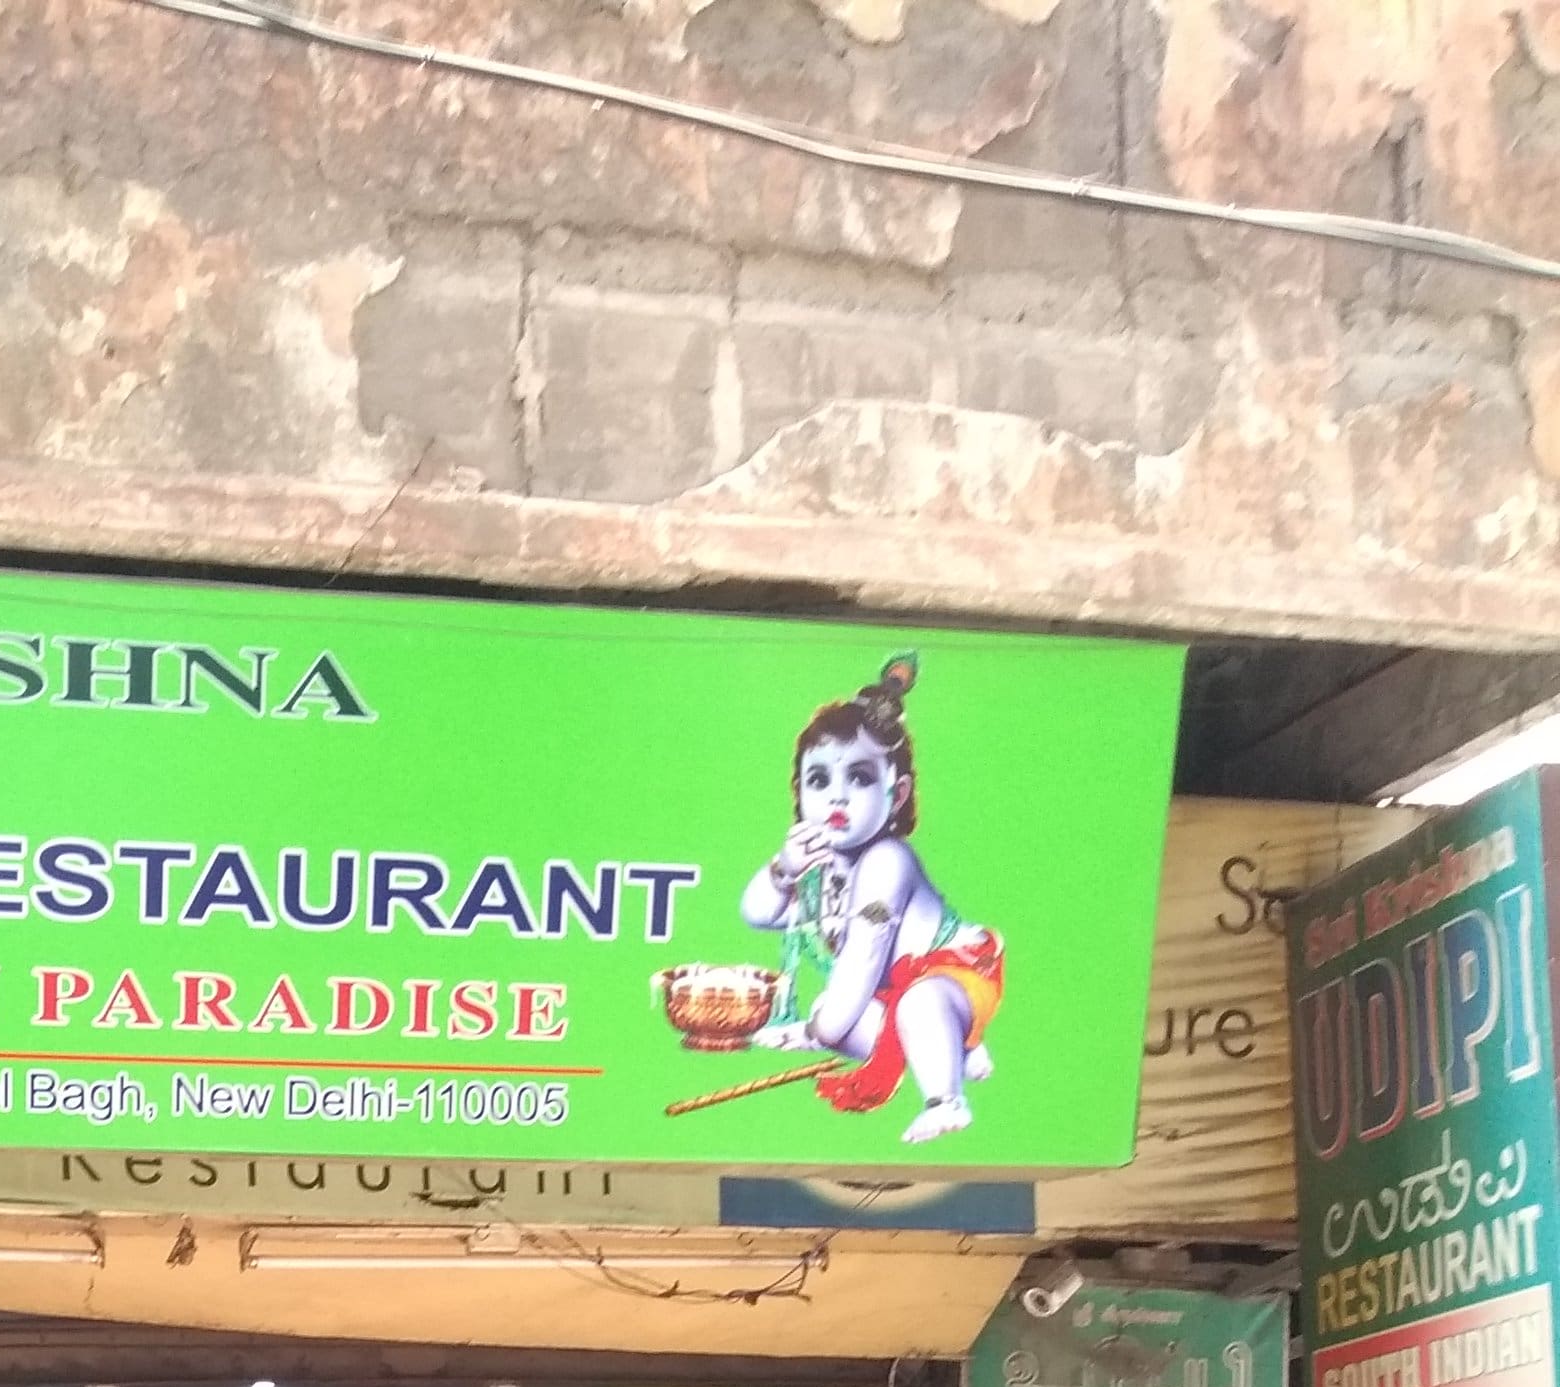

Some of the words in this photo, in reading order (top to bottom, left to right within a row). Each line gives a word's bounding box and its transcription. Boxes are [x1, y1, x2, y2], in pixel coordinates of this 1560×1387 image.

[32, 965, 569, 1042] PARADISE
[1296, 883, 1540, 1160] UDIPI
[23, 1072, 158, 1124] Bagh,
[171, 1076, 274, 1120] New
[285, 1077, 569, 1126] Delhi-110005
[1316, 1203, 1543, 1336] RESTAURANT
